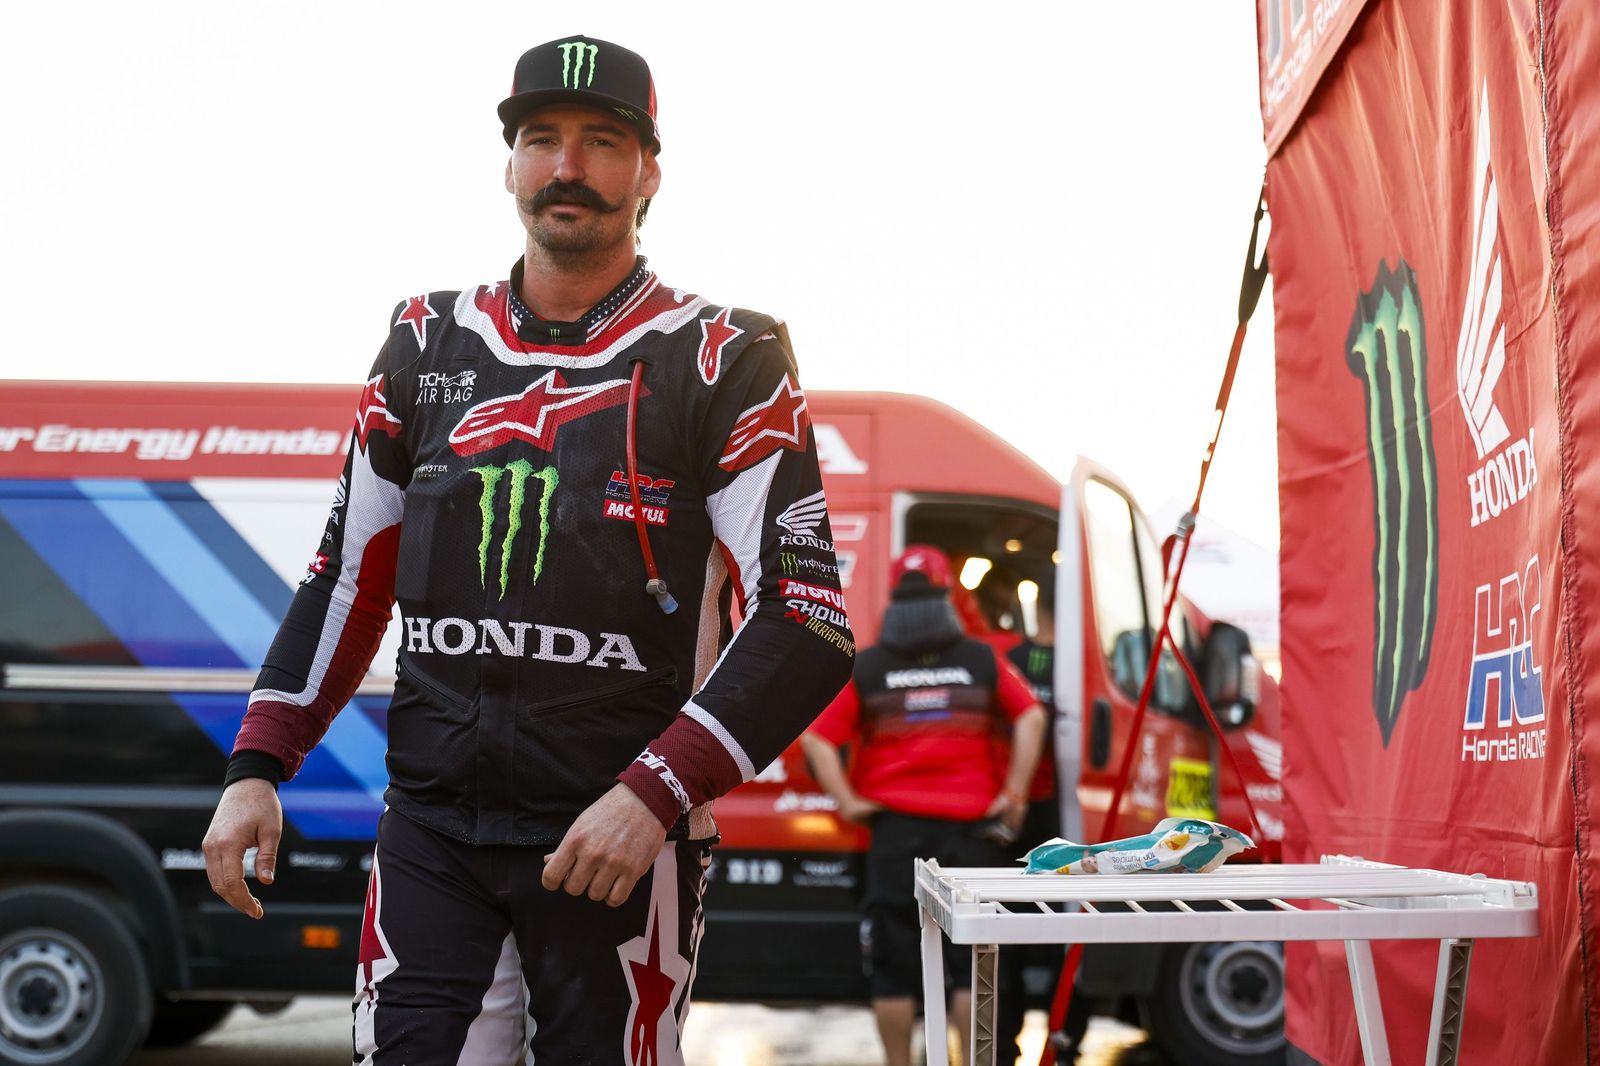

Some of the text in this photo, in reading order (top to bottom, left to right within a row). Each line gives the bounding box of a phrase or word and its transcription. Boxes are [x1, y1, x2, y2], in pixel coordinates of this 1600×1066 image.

[415, 387, 474, 406] AIR BAG
[33, 424, 200, 460] Energy
[200, 426, 341, 455] Honda
[798, 558, 839, 574] MONSTE
[404, 617, 648, 673] HONDA
[1463, 553, 1545, 731] HRC
[1461, 731, 1518, 762] Honda
